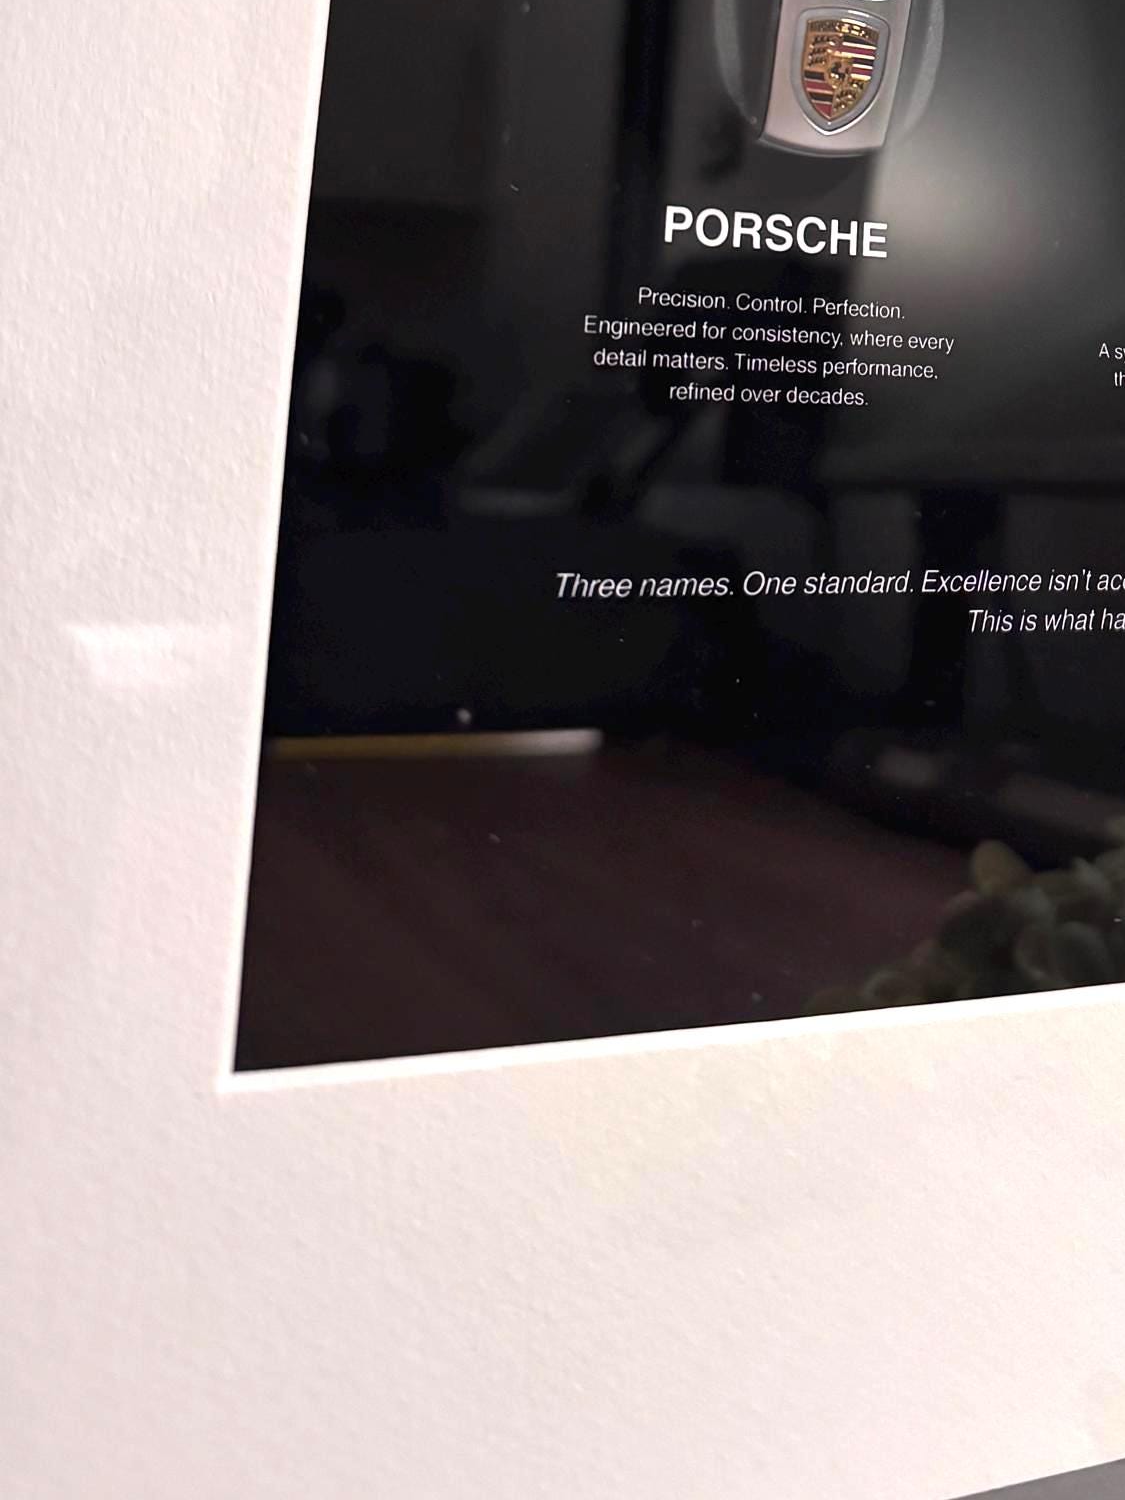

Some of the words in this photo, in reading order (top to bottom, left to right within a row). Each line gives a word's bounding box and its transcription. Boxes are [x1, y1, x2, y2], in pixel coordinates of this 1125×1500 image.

[663, 204, 888, 259] PORSCHE
[638, 287, 731, 311] Precision.
[735, 293, 807, 315] Control.
[813, 298, 906, 320] Perfection.
[583, 315, 697, 341] Engineered
[701, 322, 728, 341] for
[732, 324, 843, 348] consistency,
[849, 330, 904, 350] where
[908, 334, 954, 355] every
[1099, 343, 1110, 358] A
[593, 347, 647, 368] detail
[652, 352, 729, 372] matters.
[734, 353, 817, 375] Timeless
[822, 357, 938, 381] performance,
[669, 383, 735, 403] refined
[740, 386, 783, 404] over
[786, 386, 868, 406] decades.
[556, 572, 632, 598] Three
[638, 574, 734, 597] names.
[743, 570, 797, 596] One
[803, 570, 914, 595] standard.
[921, 569, 1042, 593] Excellence
[1048, 568, 1091, 592] isn't
[969, 608, 1013, 633] This
[1019, 609, 1038, 632] is
[1043, 607, 1095, 632] what
